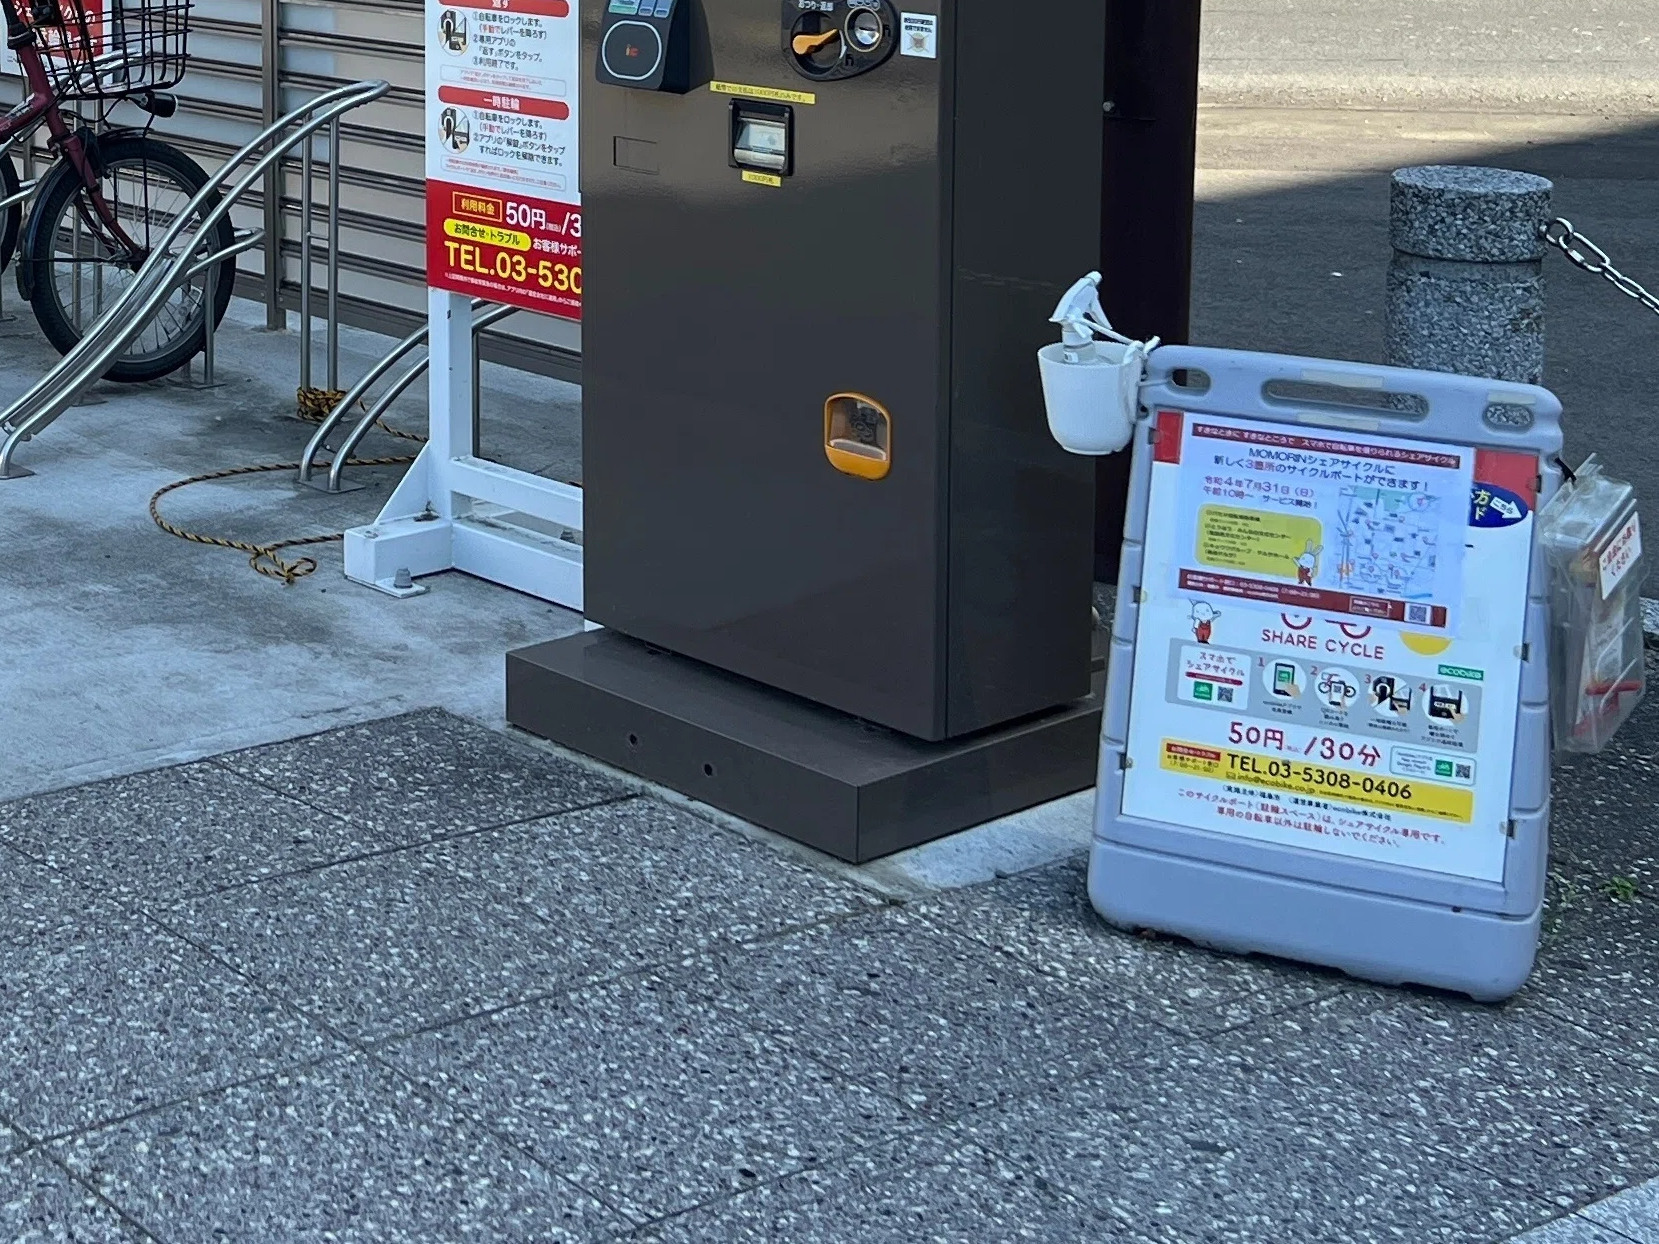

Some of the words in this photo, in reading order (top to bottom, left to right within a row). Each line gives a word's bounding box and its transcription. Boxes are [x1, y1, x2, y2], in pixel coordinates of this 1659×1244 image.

[461, 197, 495, 216] 利用料金
[1261, 628, 1318, 649] SHARE
[1325, 638, 1385, 660] CYCLE
[1199, 651, 1237, 665] スマホで
[1258, 656, 1265, 667] 1
[1186, 659, 1245, 677] シェアサイクル
[1310, 665, 1318, 676] 2
[1364, 674, 1372, 684] 3
[1418, 682, 1428, 693] 4
[1226, 752, 1413, 800] TEL.03-5308-0406
[1237, 772, 1316, 795] info@ecobike.co.jp
